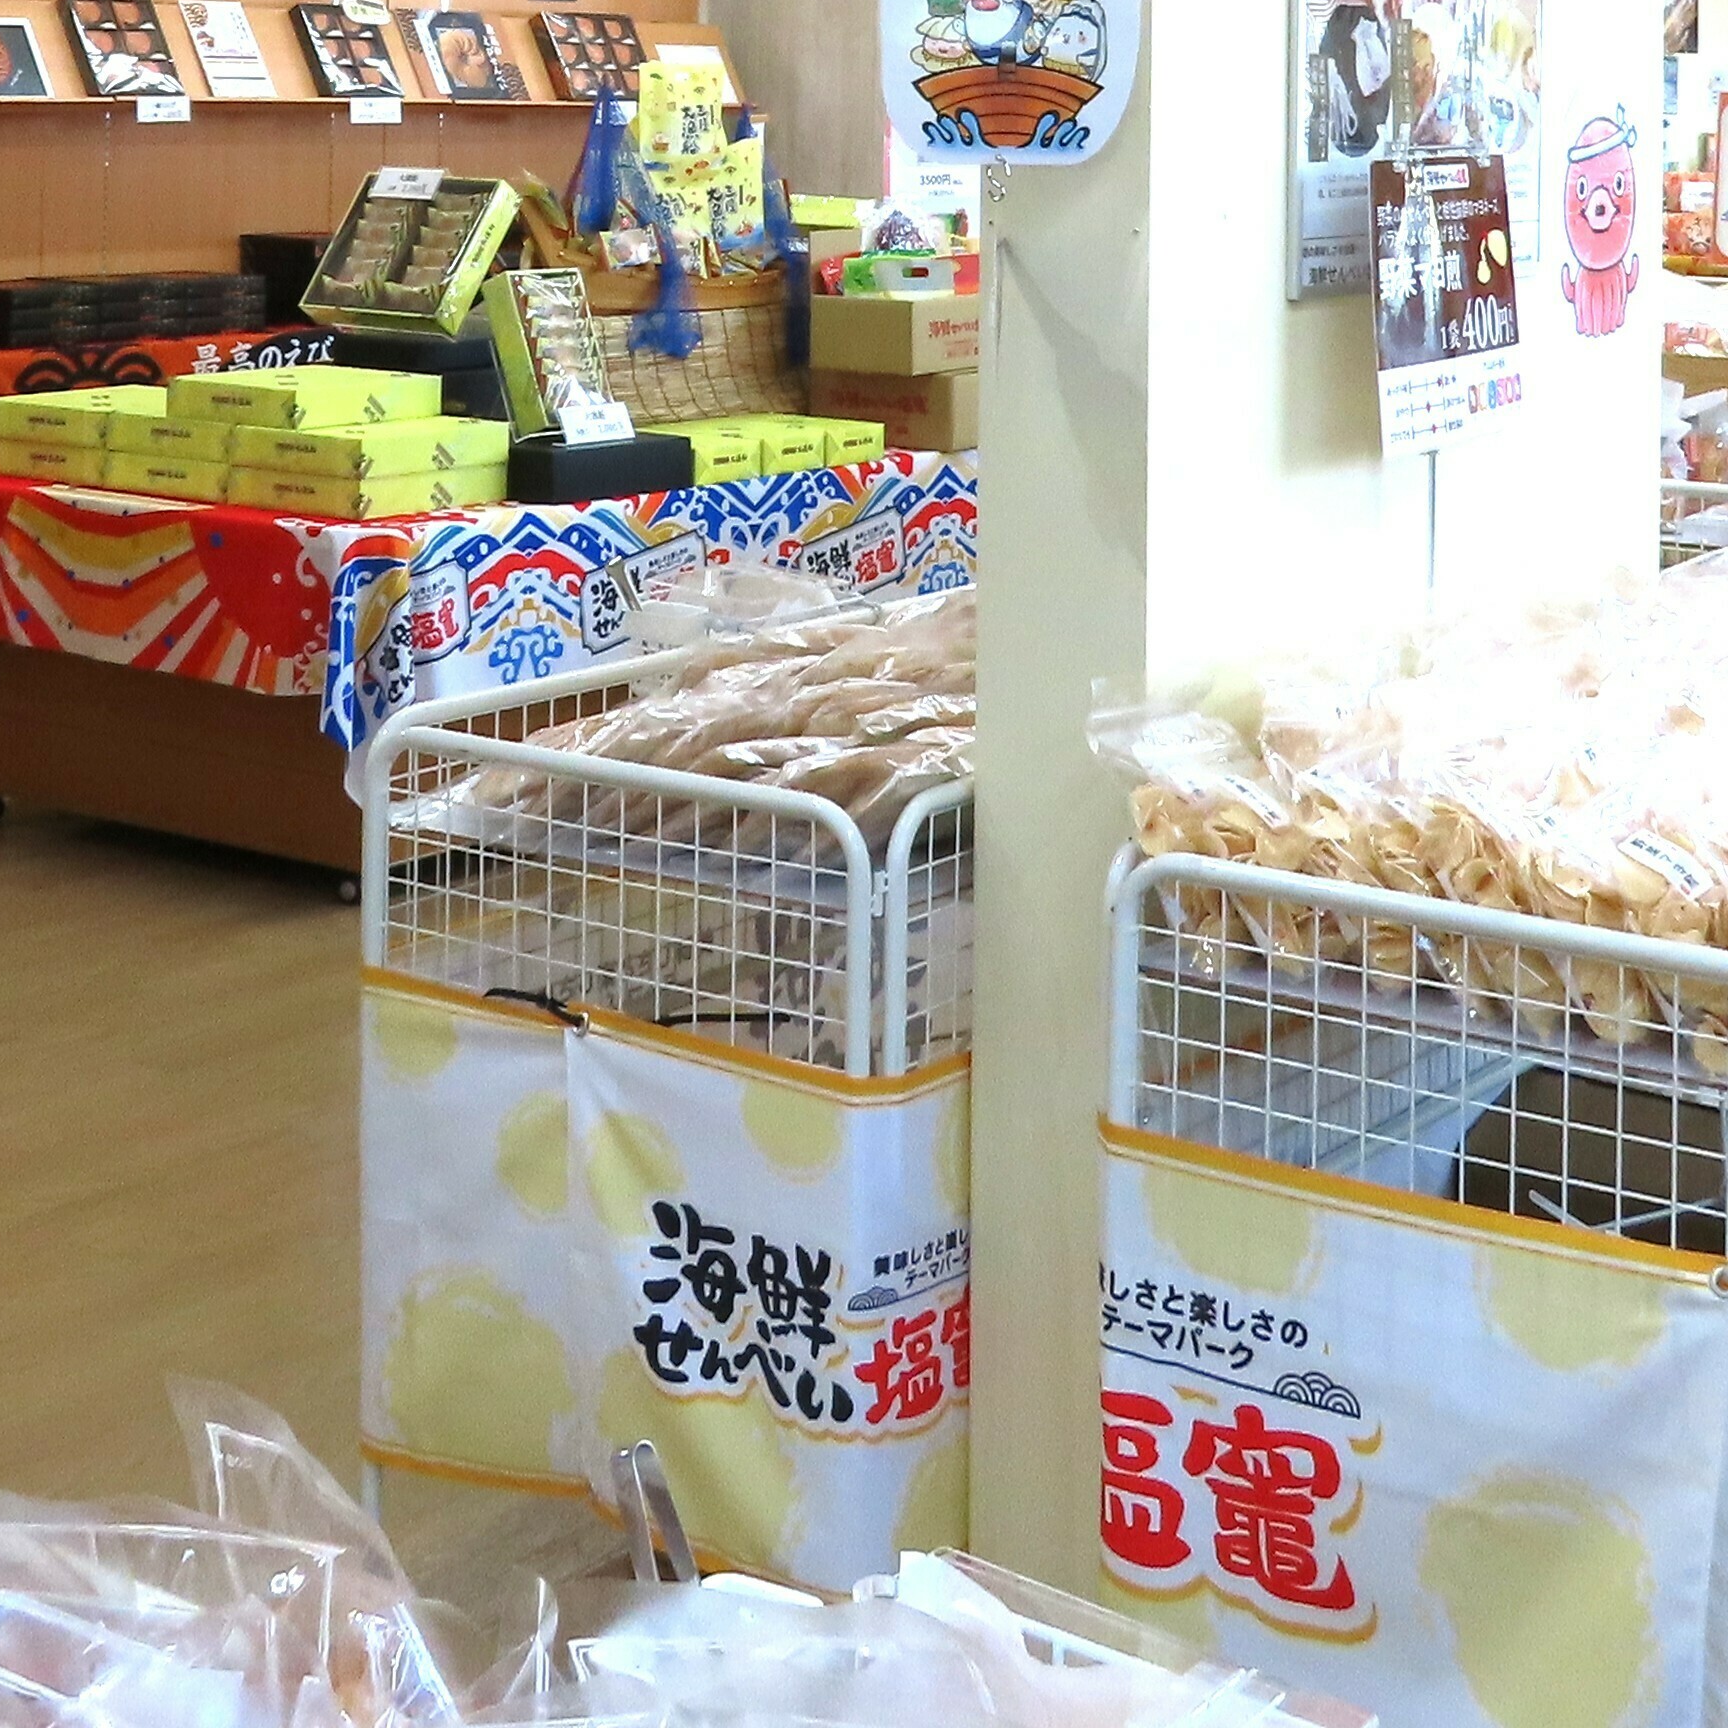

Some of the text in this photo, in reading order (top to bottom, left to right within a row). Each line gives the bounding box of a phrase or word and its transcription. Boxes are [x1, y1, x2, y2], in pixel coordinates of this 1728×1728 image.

[191, 334, 337, 372] 最高のえび
[642, 1199, 836, 1360] 海鮮
[1099, 1262, 1309, 1350] しさと楽しさの
[633, 1313, 855, 1423] せんべい
[1101, 1302, 1256, 1371] テーマパーク
